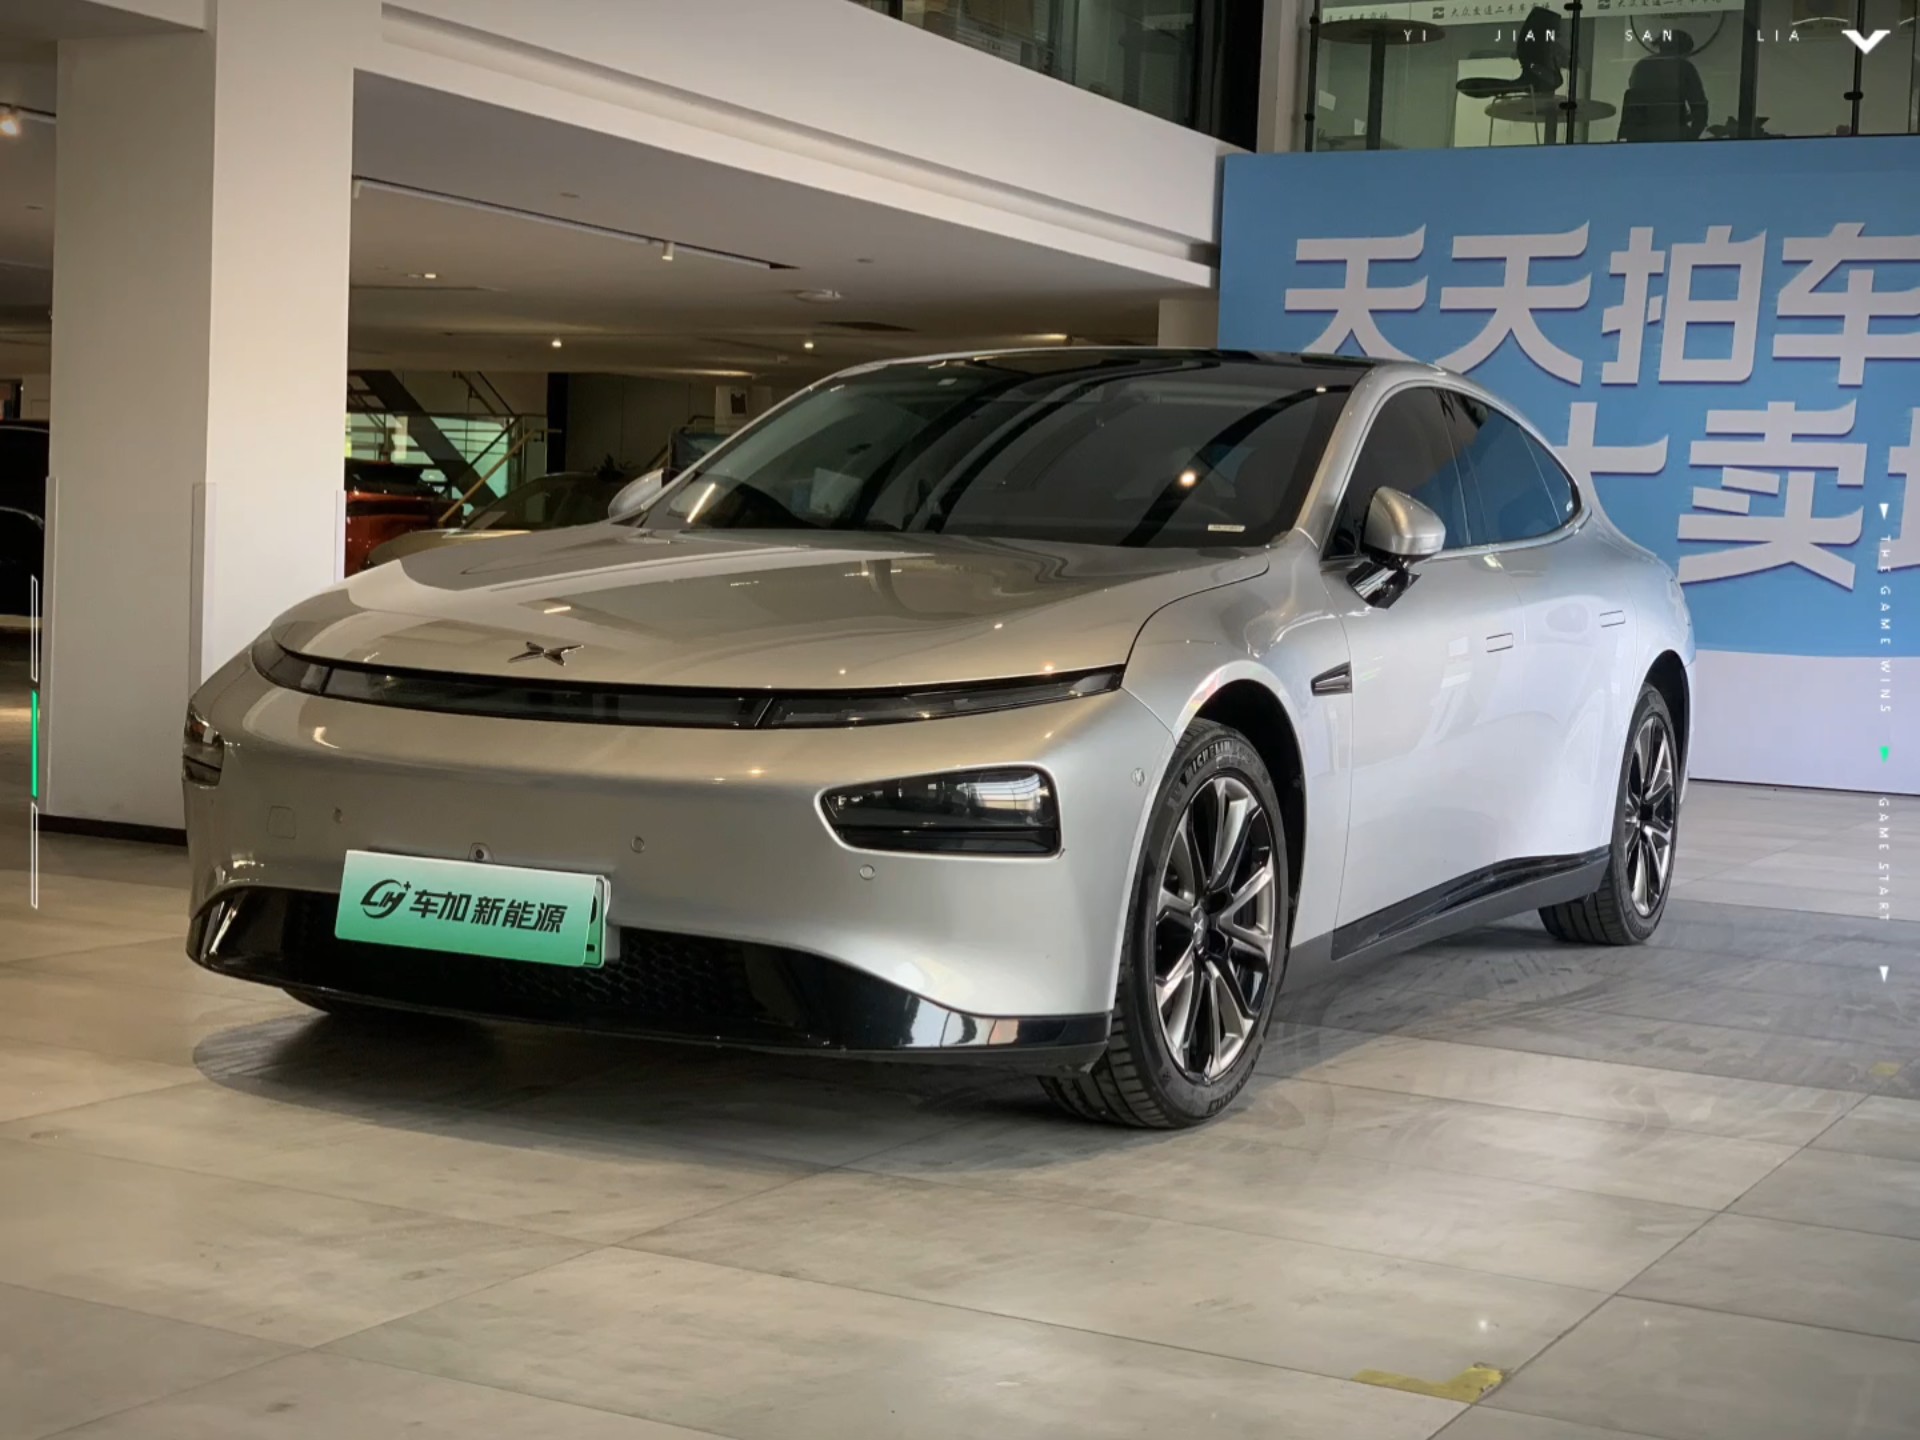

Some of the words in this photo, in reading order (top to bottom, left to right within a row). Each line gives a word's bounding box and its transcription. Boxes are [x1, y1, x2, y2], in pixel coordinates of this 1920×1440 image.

[1284, 219, 1920, 388] 天天拍车
[409, 889, 568, 933] 车加新能源
